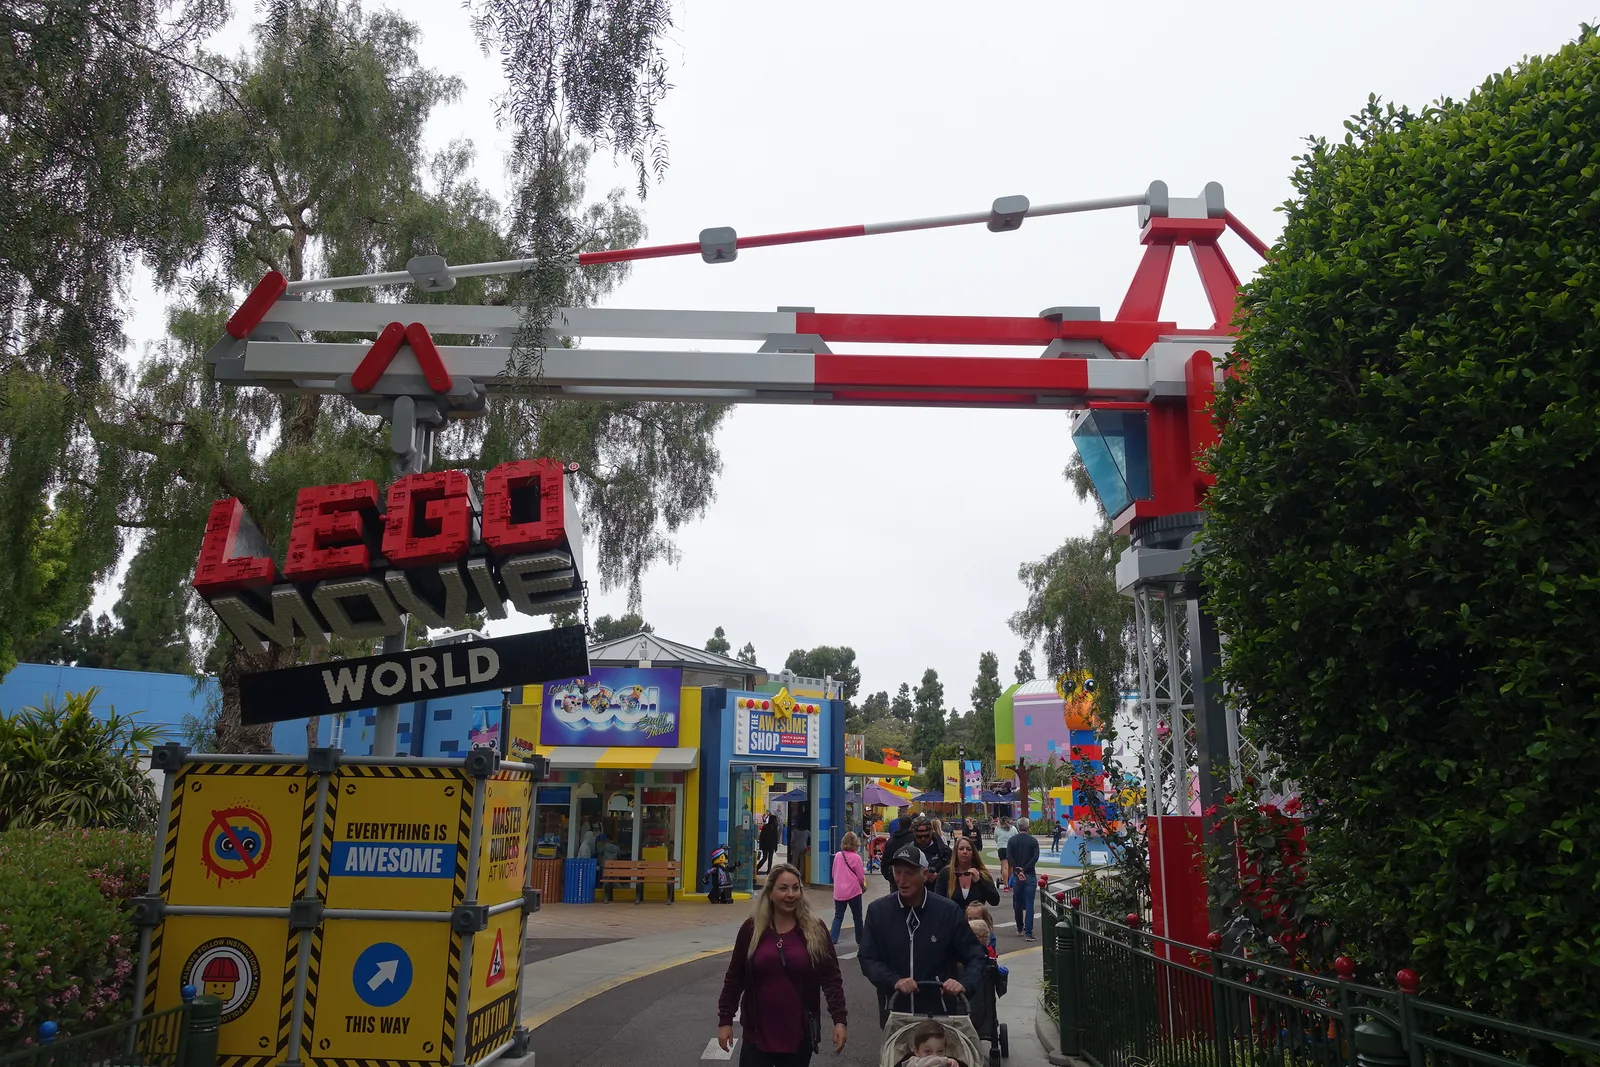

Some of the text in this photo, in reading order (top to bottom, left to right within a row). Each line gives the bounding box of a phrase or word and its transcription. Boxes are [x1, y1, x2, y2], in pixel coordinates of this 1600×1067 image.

[193, 457, 570, 597] LEGO
[211, 549, 583, 654] MOVIE
[321, 646, 501, 705] WORLD
[645, 722, 675, 740] Inside
[750, 713, 759, 731] THE
[758, 714, 807, 734] AWESOME
[750, 731, 780, 751] SHOP
[346, 822, 448, 841] EVERYTHING IS
[491, 807, 522, 836] MASTER
[344, 847, 443, 874] AWESOME
[489, 836, 520, 863] BUILDERS
[487, 861, 519, 882] AT WORK
[182, 939, 259, 980] ALWAYS FOLLOW INSTRUCTIONS
[222, 982, 259, 1022] ALWAYS FOLLO
[345, 1016, 411, 1035] THIS WAY
[471, 998, 511, 1047] CAUTION
